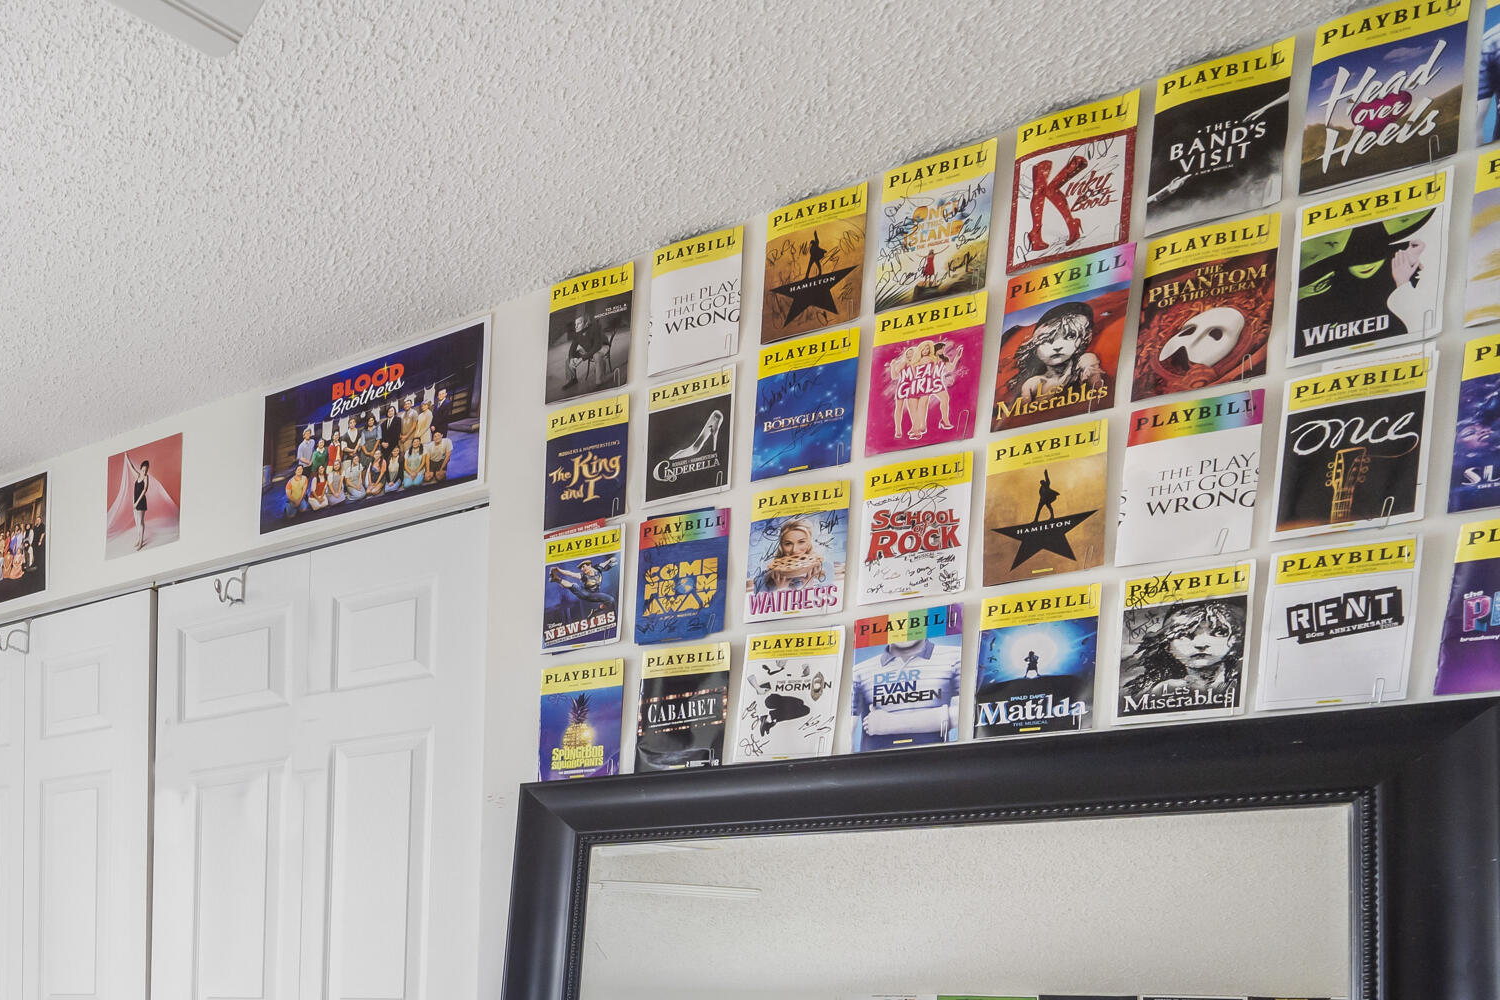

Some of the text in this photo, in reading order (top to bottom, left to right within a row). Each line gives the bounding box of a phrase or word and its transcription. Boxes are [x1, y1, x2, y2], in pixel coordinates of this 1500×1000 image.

[1322, 0, 1461, 47] PLAYBILL
[1161, 48, 1286, 98] PLAYBILL
[1316, 39, 1447, 127] Head
[1021, 103, 1128, 143] PLAYBILL
[1355, 99, 1410, 124] over
[1169, 121, 1267, 161] BAND'S
[1205, 120, 1231, 134] THE
[1315, 97, 1439, 174] Heels
[888, 149, 988, 189] PLAYBILL
[1179, 141, 1252, 173] VISIT
[773, 193, 861, 228] PLAYBILL
[1306, 180, 1441, 226] PLAYBILL
[655, 234, 736, 266] PLAYBILL
[1153, 222, 1270, 262] PLAYBILL
[789, 275, 836, 293] HAMILTON
[1009, 255, 1127, 300] PLAYBILL
[1148, 263, 1268, 304] PHANTOM
[1195, 263, 1224, 277] THE
[553, 271, 629, 301] PLAYBILL
[674, 278, 739, 306] THE PLAY
[1157, 280, 1256, 309] OF THE OPERA
[664, 308, 741, 335] WRONG
[666, 303, 696, 319] THAT
[880, 302, 977, 333] PLAYBILL
[763, 336, 851, 367] PLAYBILL
[331, 363, 405, 401] BLOOD
[900, 361, 946, 383] MEAN
[1294, 364, 1424, 399] PLAYBILL
[330, 377, 405, 418] Brothers
[651, 373, 731, 402] PLAYBILL
[897, 377, 944, 400] GIRLS
[550, 403, 624, 429] PLAYBILL
[763, 407, 845, 433] BODYGUARD
[1136, 398, 1257, 432] PLAYBILL
[995, 429, 1100, 461] PLAYBILL
[549, 451, 622, 488] The King
[870, 461, 964, 488] PLAYBILL
[1158, 451, 1256, 482] THE PLAY
[560, 477, 601, 503] and I
[757, 486, 843, 509] PLAYBILL
[1146, 487, 1257, 517] WRONG
[1147, 479, 1193, 497] THAT
[643, 514, 725, 539] PLAYBILL
[871, 508, 960, 531] SCHOOL
[1016, 519, 1071, 536] HAMILTON
[548, 533, 619, 555] PLAYBILL
[867, 524, 962, 562] ROCK
[644, 556, 718, 584] COME
[1281, 545, 1411, 573] PLAYBILL
[1128, 570, 1246, 598] PLAYBILL
[1463, 590, 1484, 600] the
[750, 583, 838, 616] WAITRESS
[987, 593, 1090, 617] PLAYBILL
[1290, 592, 1395, 632] RENT
[543, 611, 616, 641] NEWSIES
[860, 611, 956, 637] PLAYBILL
[752, 635, 837, 651] PLAYBILL
[646, 649, 725, 668] PLAYBILL
[545, 665, 617, 685] PLAYBILL
[872, 680, 917, 697] EVAN
[873, 669, 921, 684] DEAR
[872, 688, 942, 708] HANSEN
[1161, 683, 1190, 697] Les
[647, 698, 716, 723] CABARET
[975, 694, 1089, 727] Matilda
[551, 745, 604, 761] SPONGEBOB
